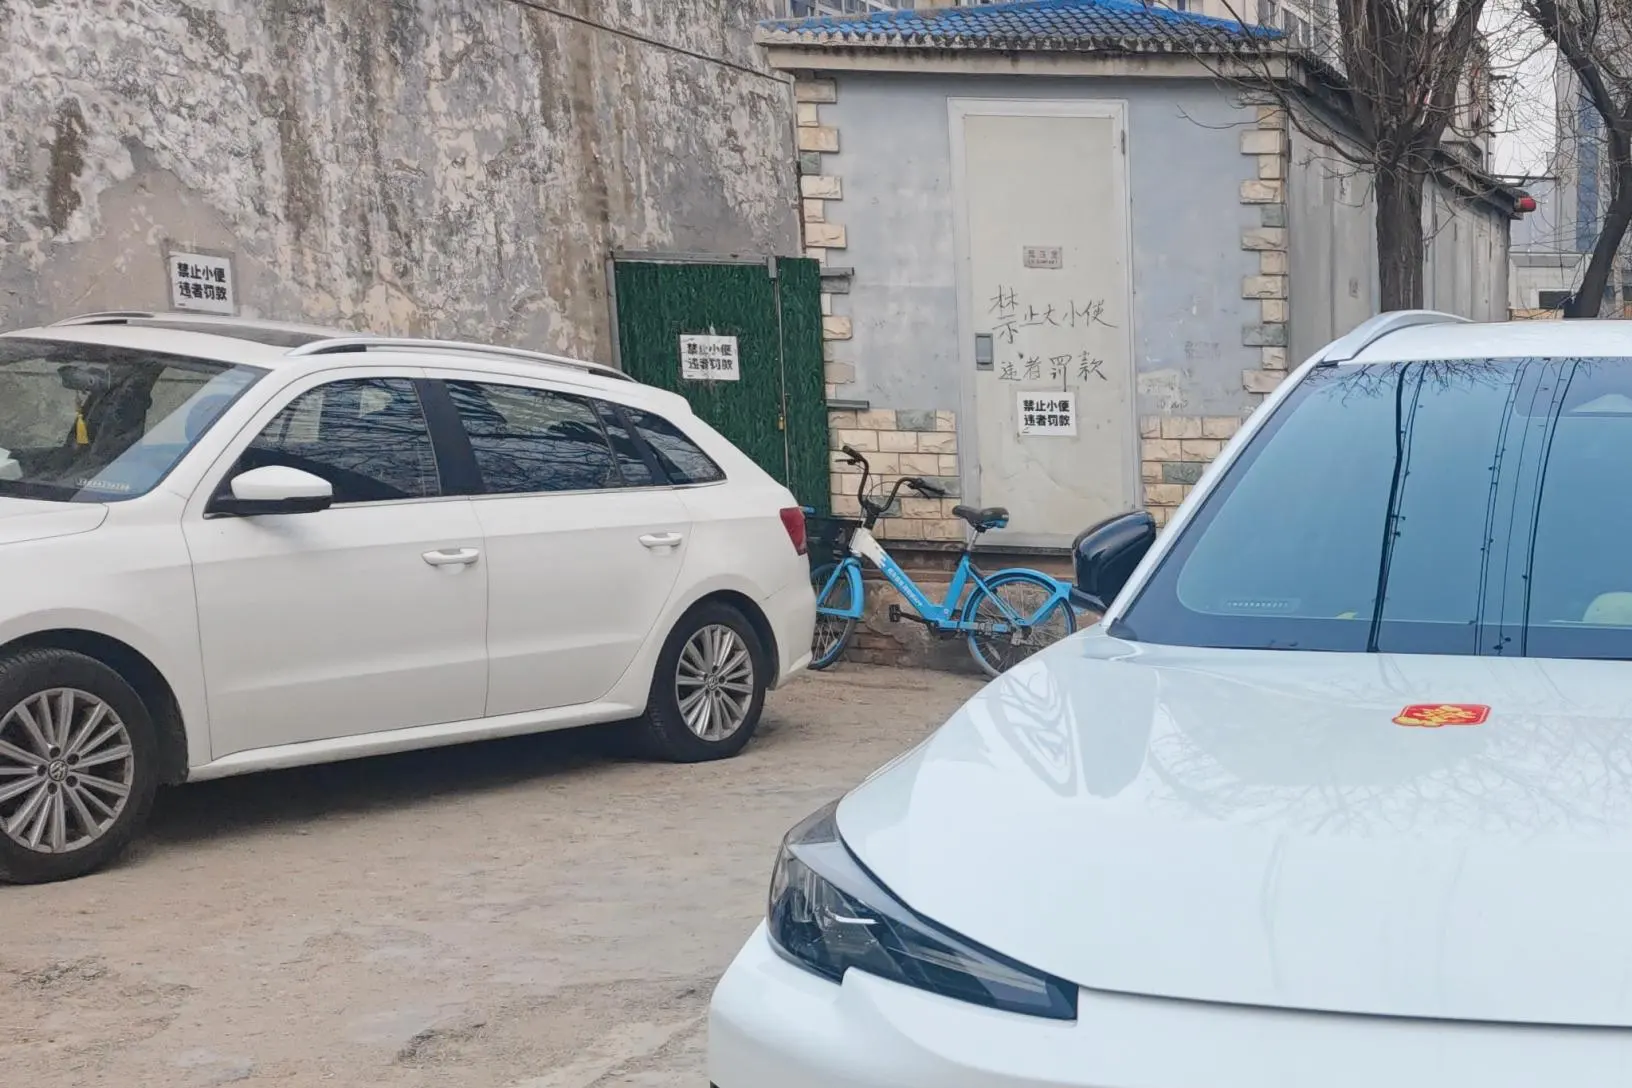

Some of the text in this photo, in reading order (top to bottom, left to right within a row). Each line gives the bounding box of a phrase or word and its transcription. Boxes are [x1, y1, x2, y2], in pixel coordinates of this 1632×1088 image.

[177, 262, 226, 283] 禁止小便
[178, 281, 228, 301] 违者罚款
[687, 342, 733, 356] 禁止小便
[688, 357, 733, 370] 违者罚款
[1023, 399, 1070, 412] 禁止小便
[1023, 414, 1071, 427] 违者罚款
